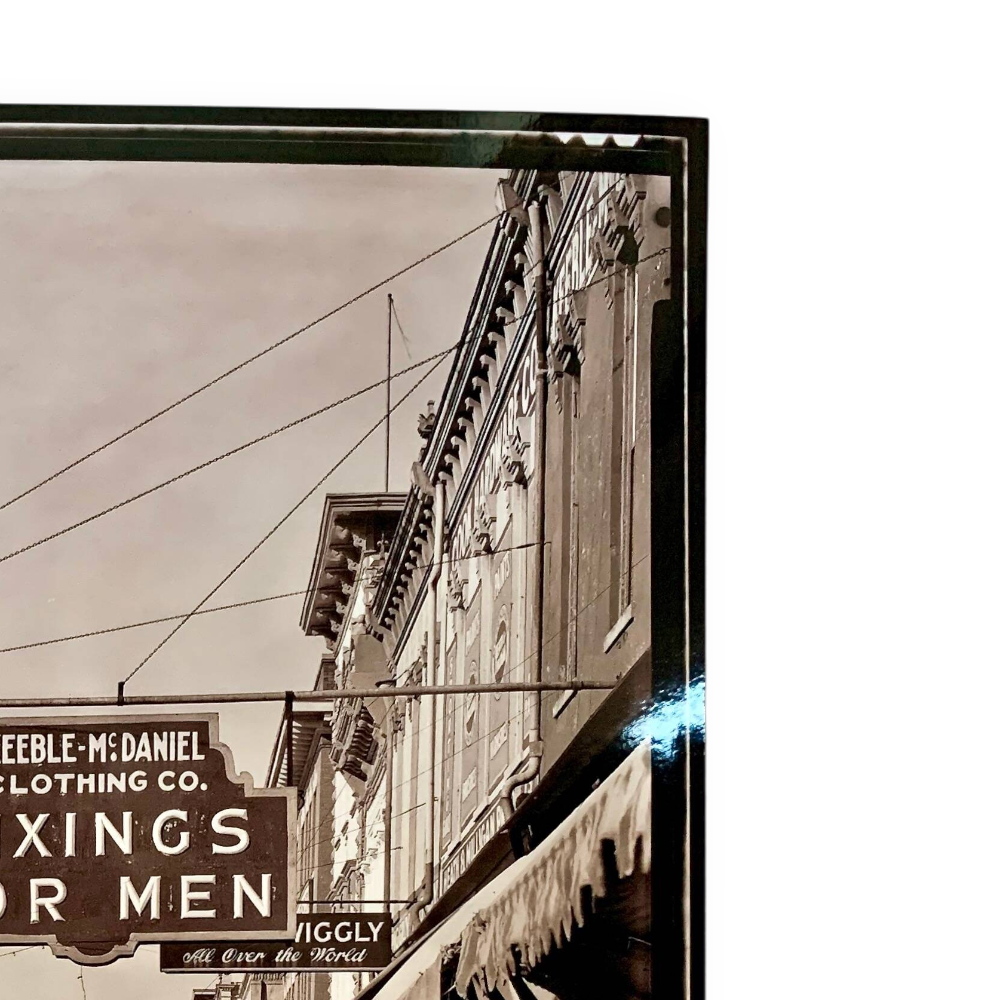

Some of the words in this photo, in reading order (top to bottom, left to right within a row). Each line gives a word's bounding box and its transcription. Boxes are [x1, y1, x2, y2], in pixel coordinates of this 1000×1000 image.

[157, 770, 208, 792] CO.
[119, 873, 273, 922] MEN
[183, 948, 216, 963] All
[221, 948, 267, 963] Over
[274, 947, 302, 963] the
[310, 947, 368, 963] World
